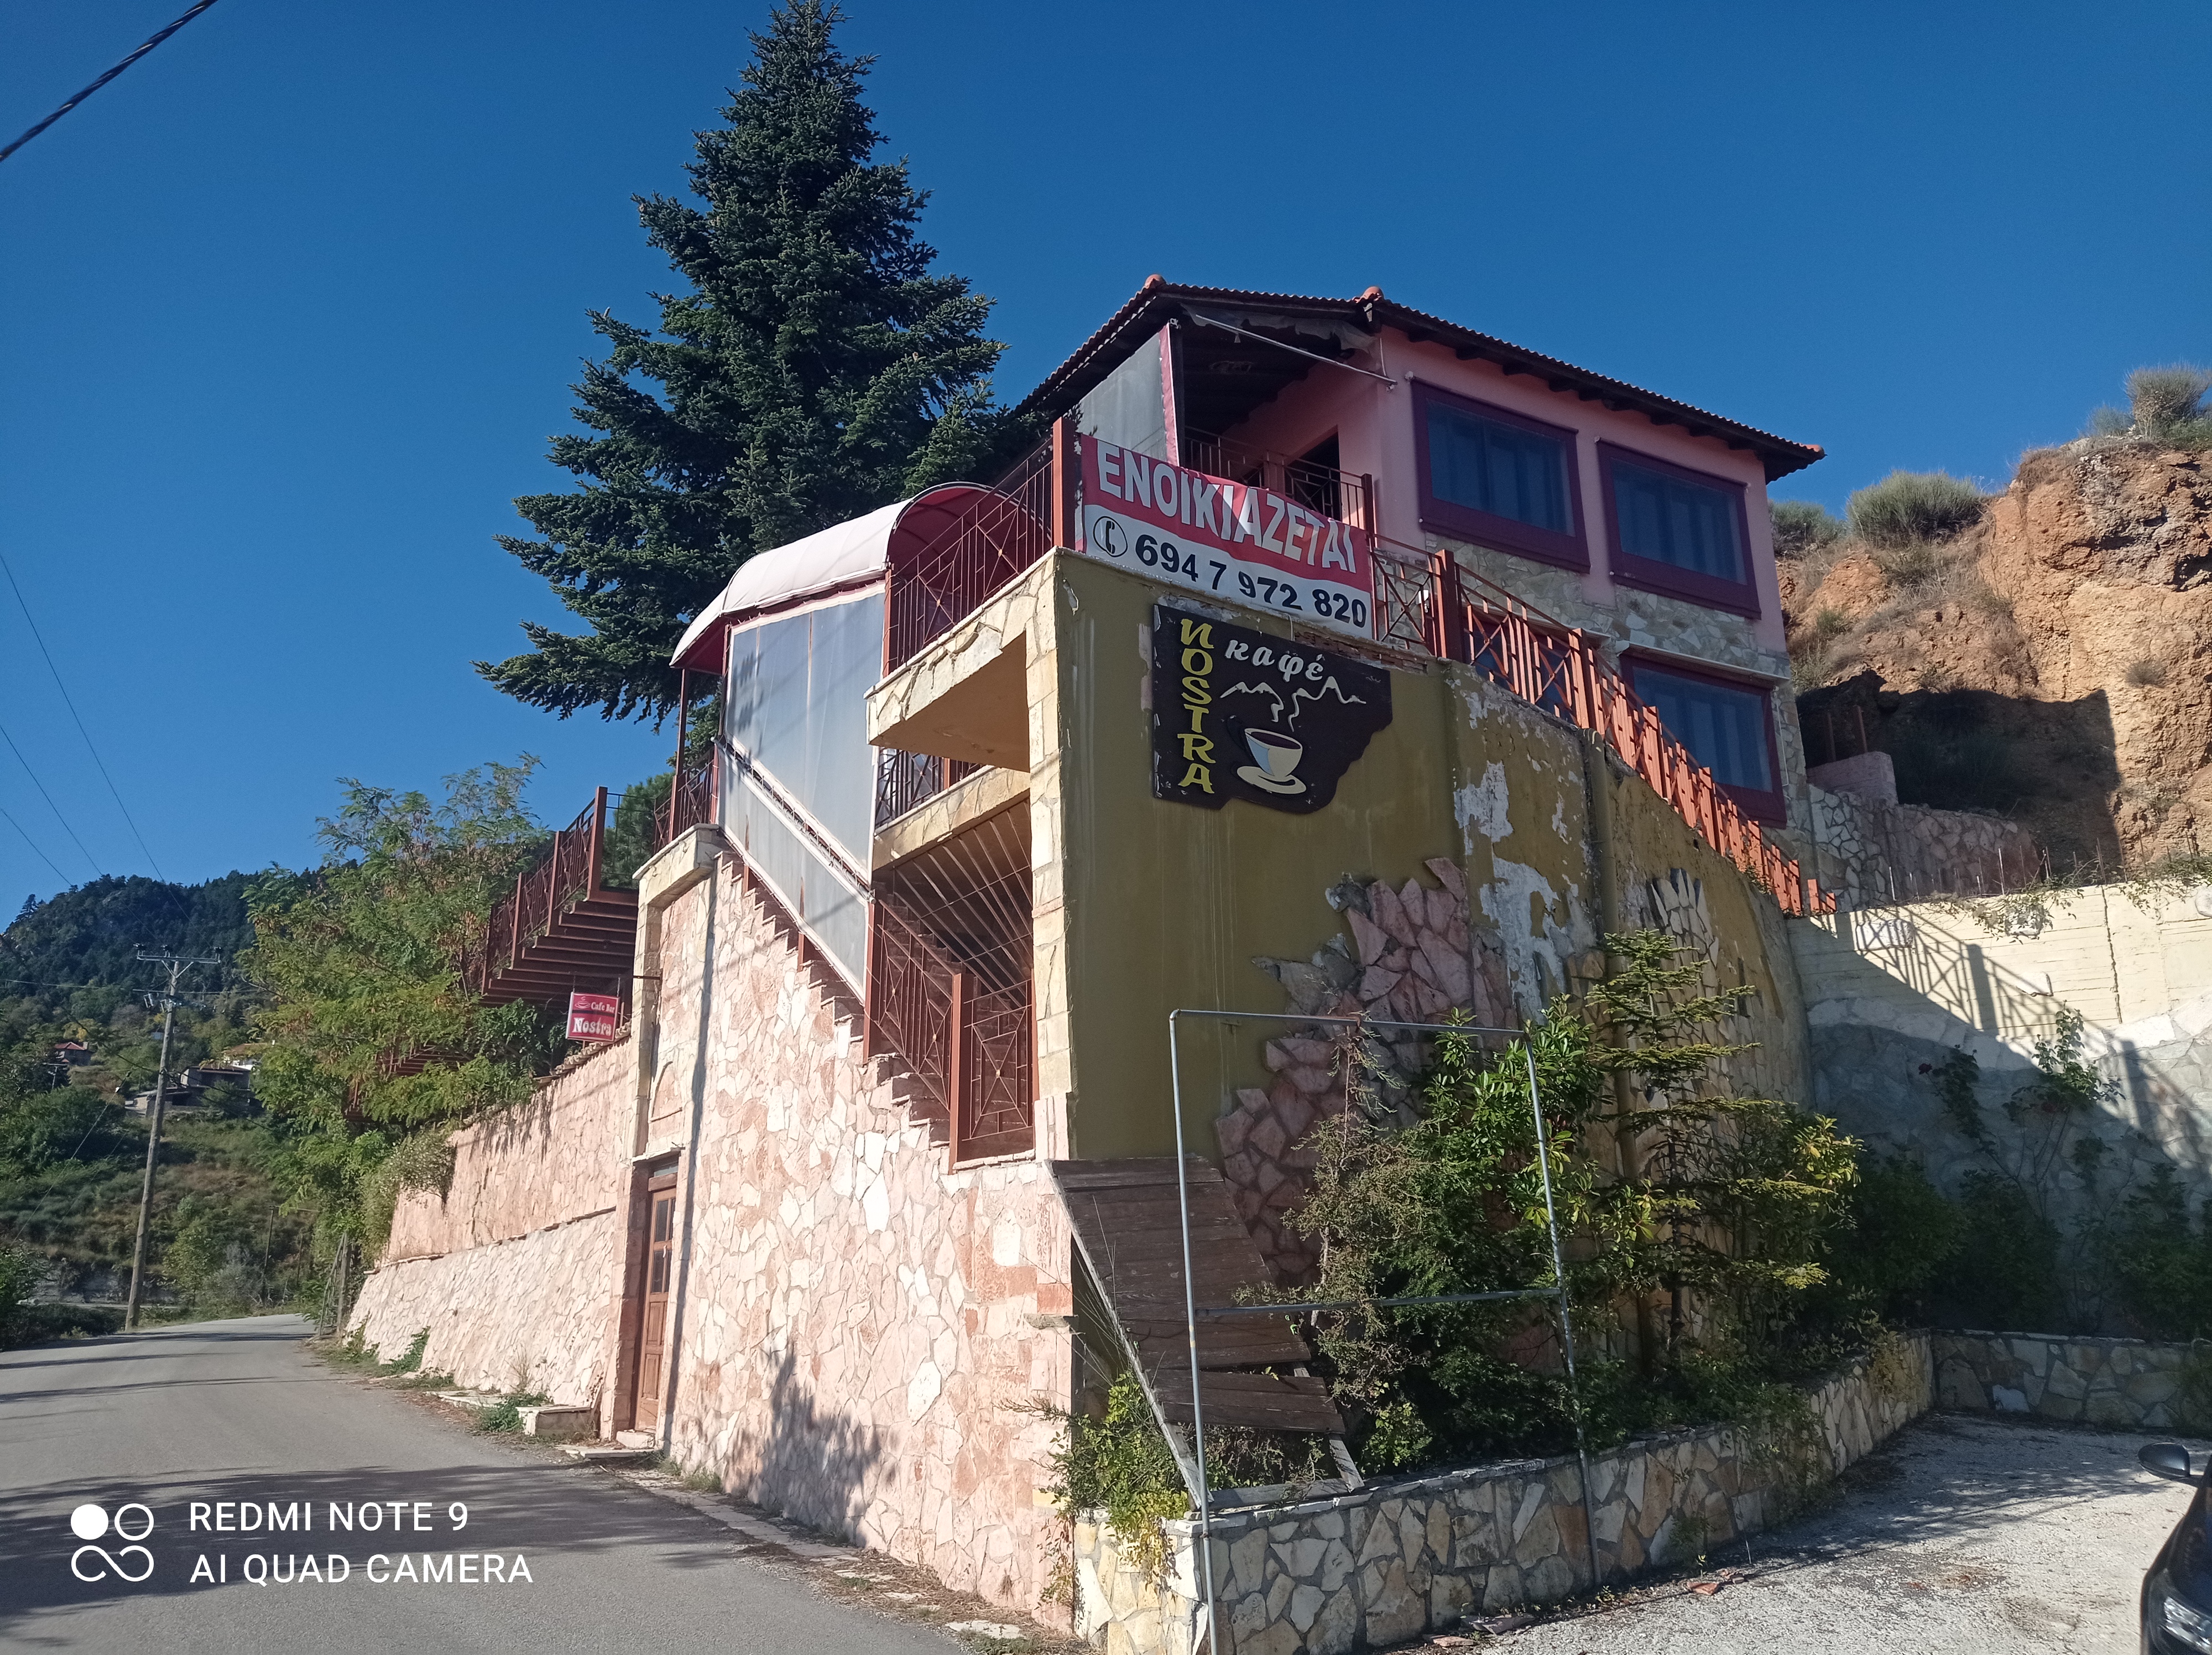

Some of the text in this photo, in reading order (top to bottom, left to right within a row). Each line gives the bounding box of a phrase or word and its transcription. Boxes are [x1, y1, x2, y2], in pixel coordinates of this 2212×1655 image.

[1097, 440, 1357, 574] ΕΝΟΙΚΙΑΖΕΤΑΙ
[1135, 534, 1367, 628] 694 7 972 820
[1224, 639, 1325, 683] καφέ
[1177, 618, 1216, 794] NOSTRA
[572, 1017, 612, 1037] Nostra
[591, 1002, 615, 1013] Cafe Bar
